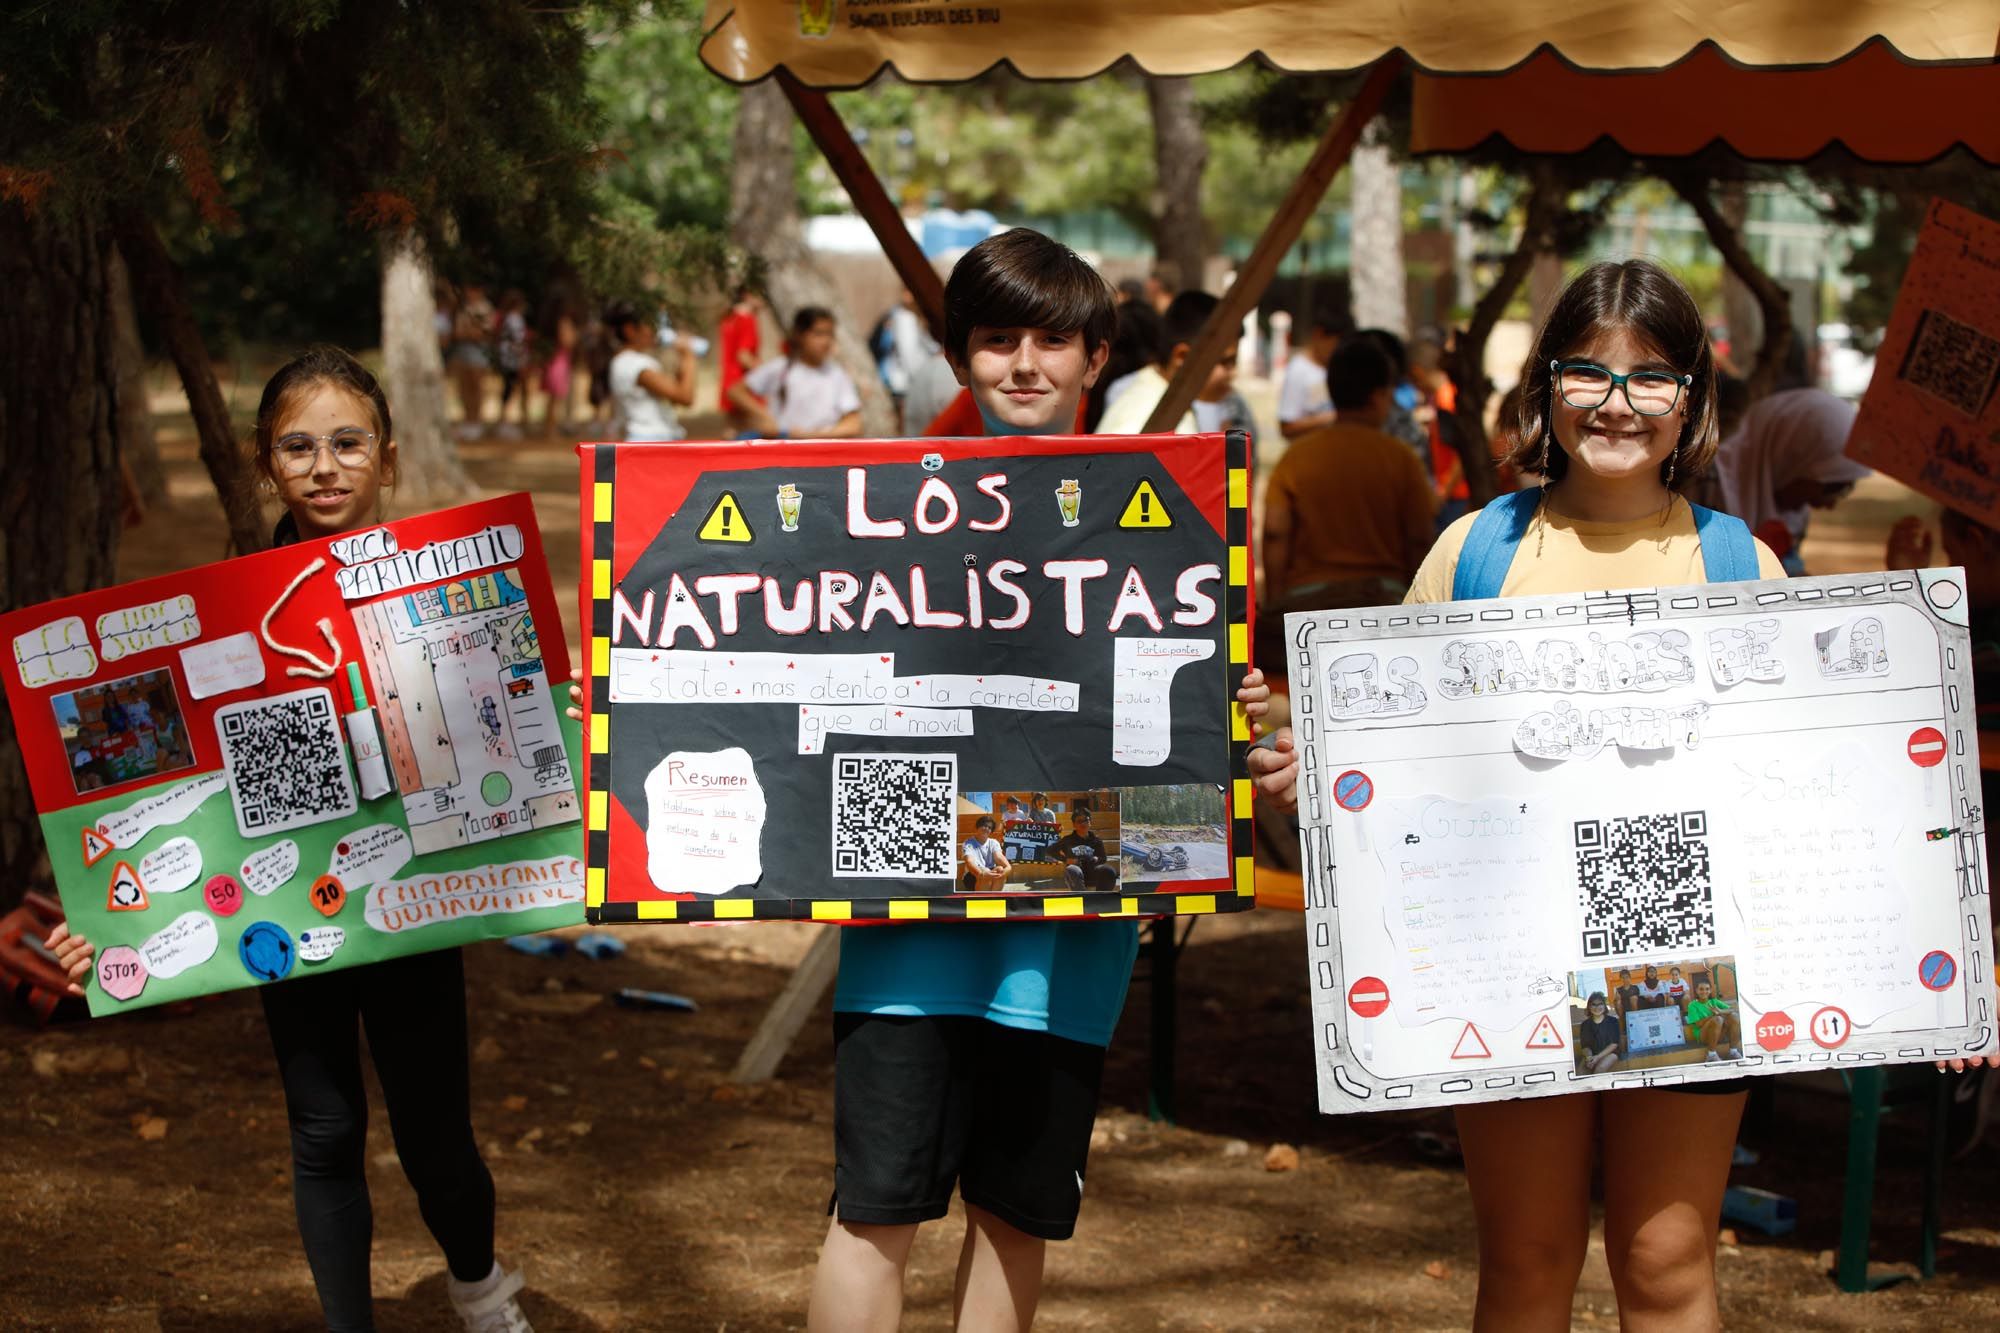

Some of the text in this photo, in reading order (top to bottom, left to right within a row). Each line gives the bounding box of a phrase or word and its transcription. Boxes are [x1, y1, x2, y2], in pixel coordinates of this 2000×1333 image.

[845, 466, 1012, 539] LOS
[752, 679, 796, 698] mas
[810, 667, 887, 700] atento
[894, 681, 911, 699] a
[930, 679, 951, 704] la
[969, 679, 1075, 711] carretera
[804, 708, 965, 753] que al movil
[669, 761, 747, 787] Resumen
[212, 883, 236, 905] 50
[316, 882, 340, 907] 20
[103, 962, 139, 981] STOP
[1758, 1024, 1794, 1039] STOP
